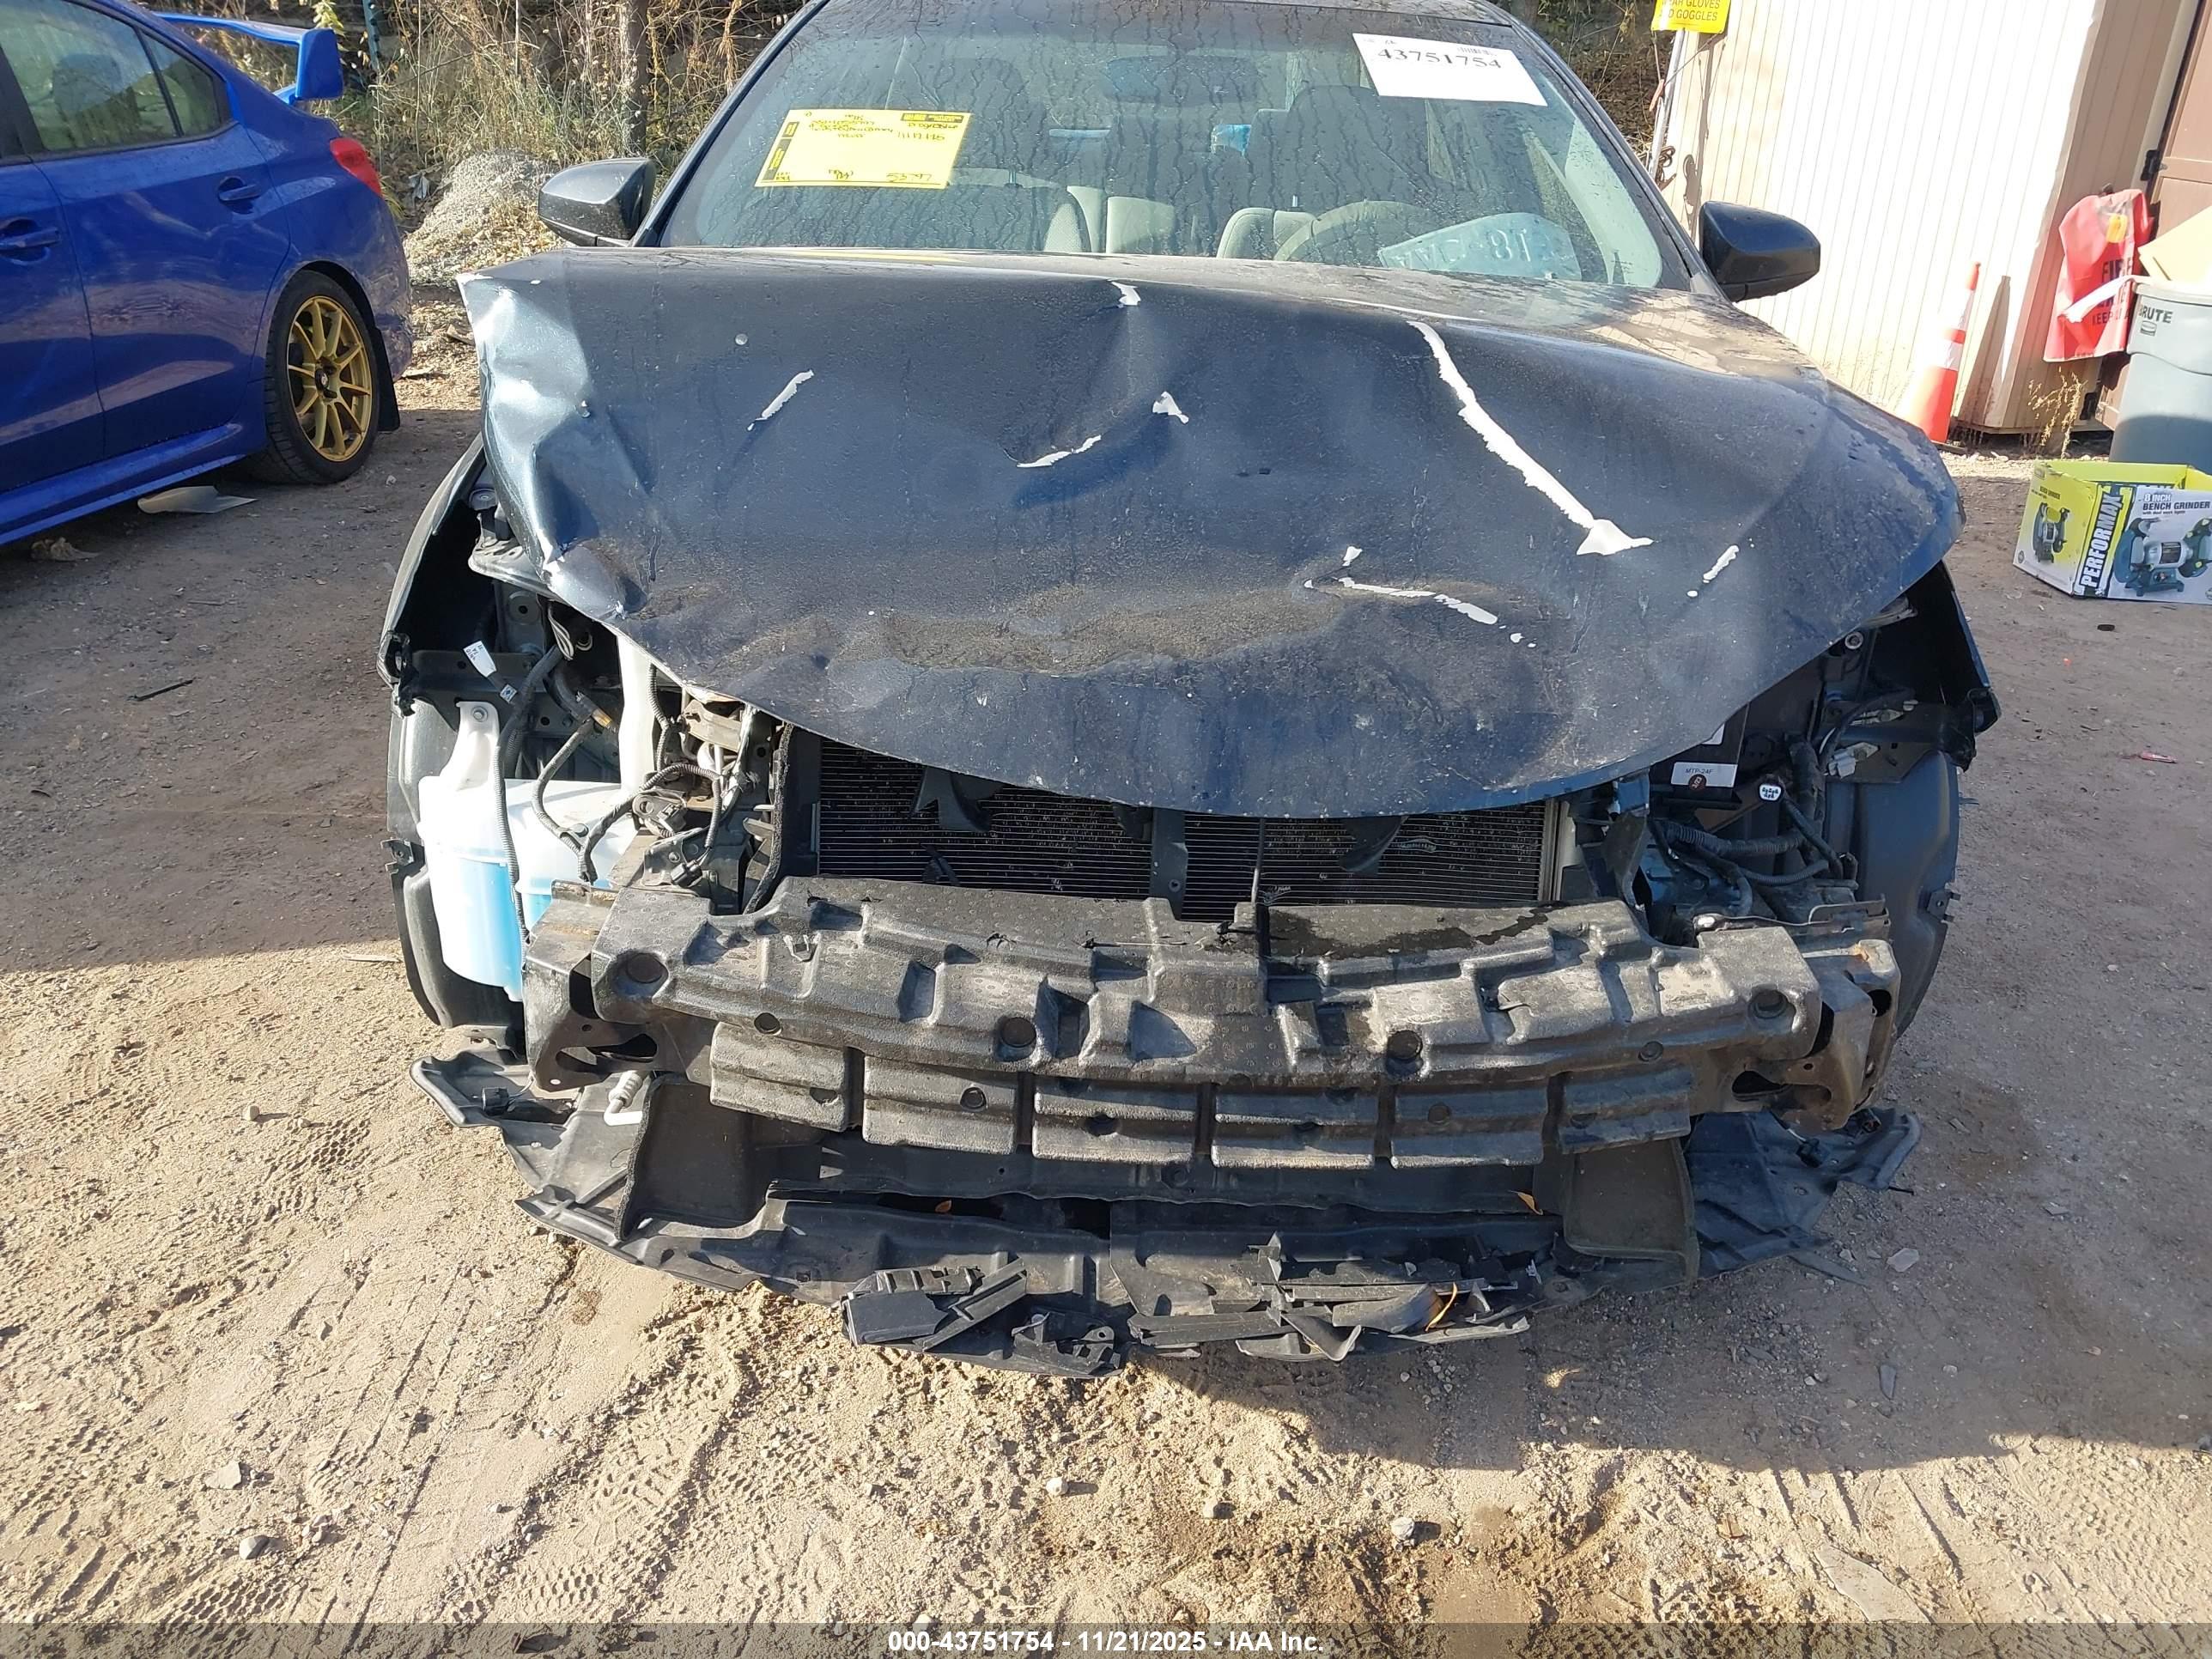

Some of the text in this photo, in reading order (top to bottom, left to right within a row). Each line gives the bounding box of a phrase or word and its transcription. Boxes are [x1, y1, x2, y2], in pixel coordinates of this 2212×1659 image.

[1686, 0, 1721, 9] GLOVES
[1676, 9, 1718, 21] GOGGLES
[1377, 48, 1503, 69] 43751754
[2144, 493, 2172, 502] 8 INCH
[2142, 501, 2211, 511] BENCH GRINDER
[2081, 494, 2124, 587] PERFORMAX
